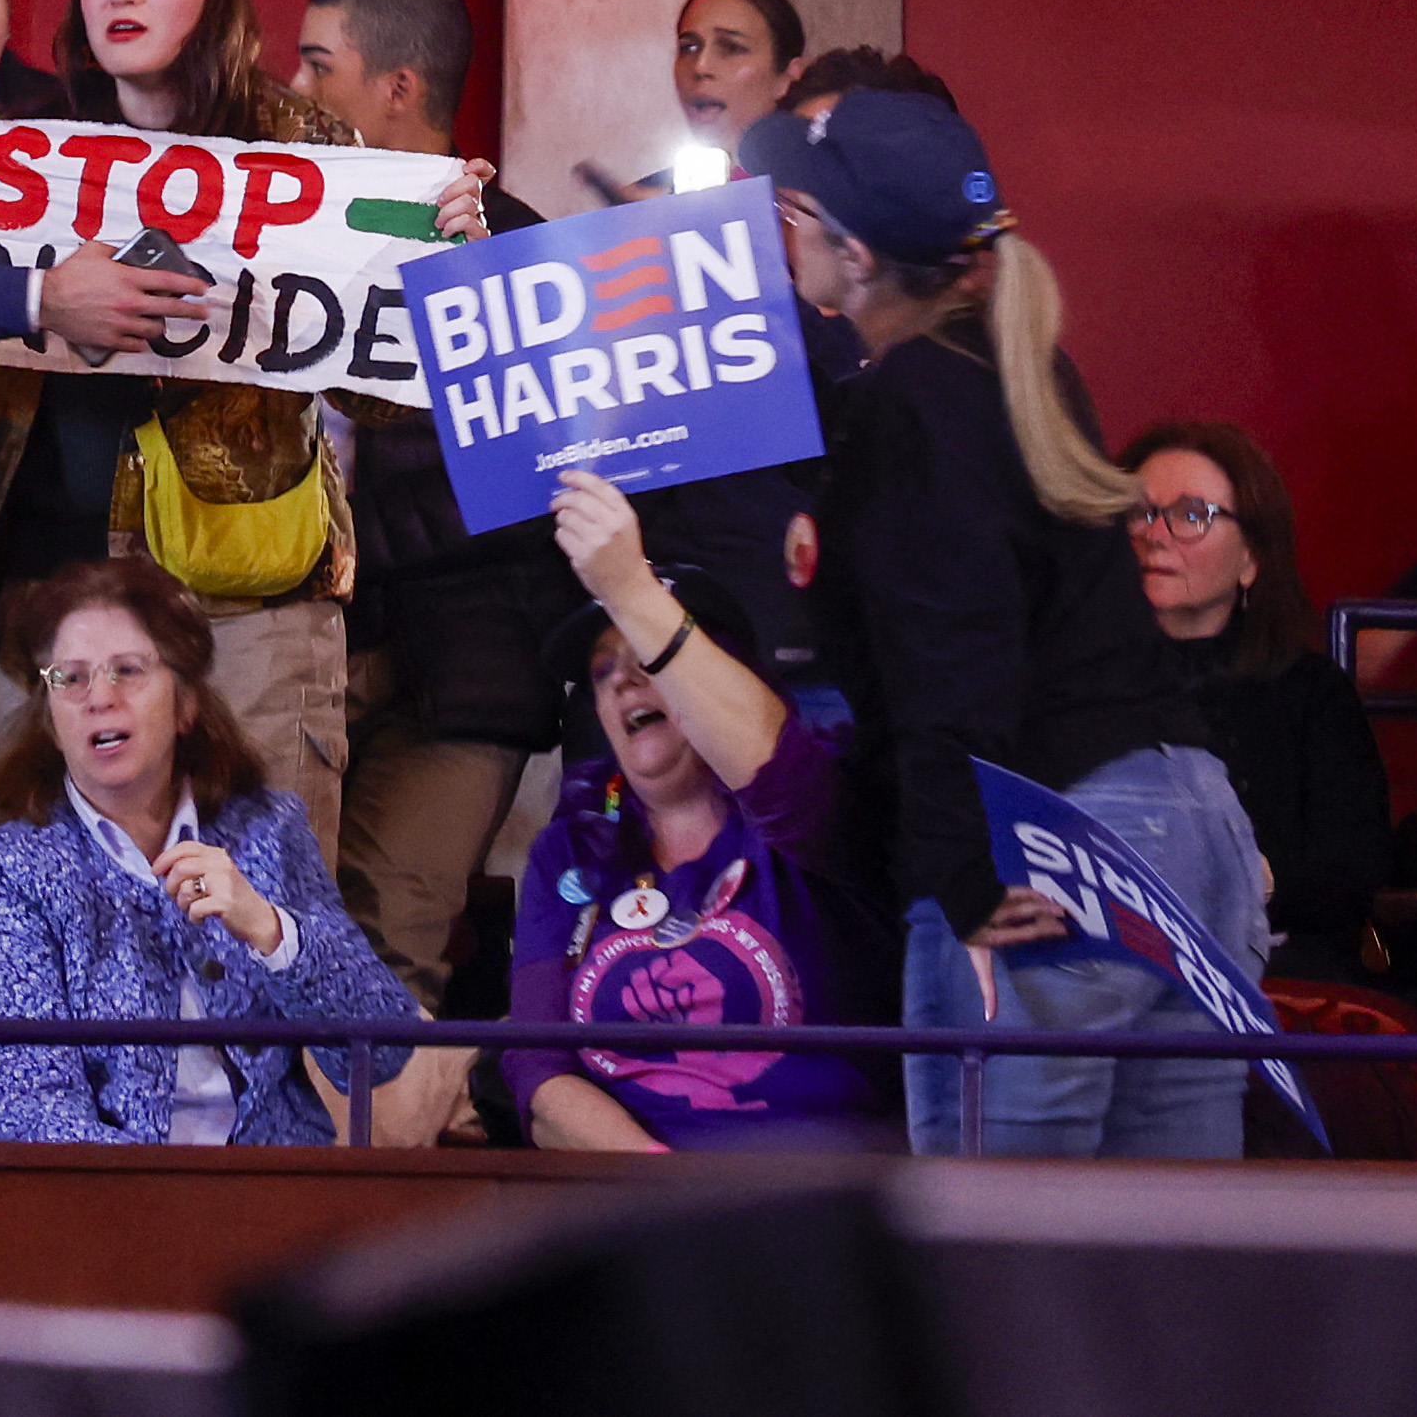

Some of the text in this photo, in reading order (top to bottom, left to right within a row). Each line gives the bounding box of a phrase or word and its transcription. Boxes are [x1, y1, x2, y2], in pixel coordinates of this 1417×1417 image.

[424, 218, 762, 373] BIDEN
[445, 313, 778, 448] HARRIS
[534, 425, 690, 473] JoeBiden.com
